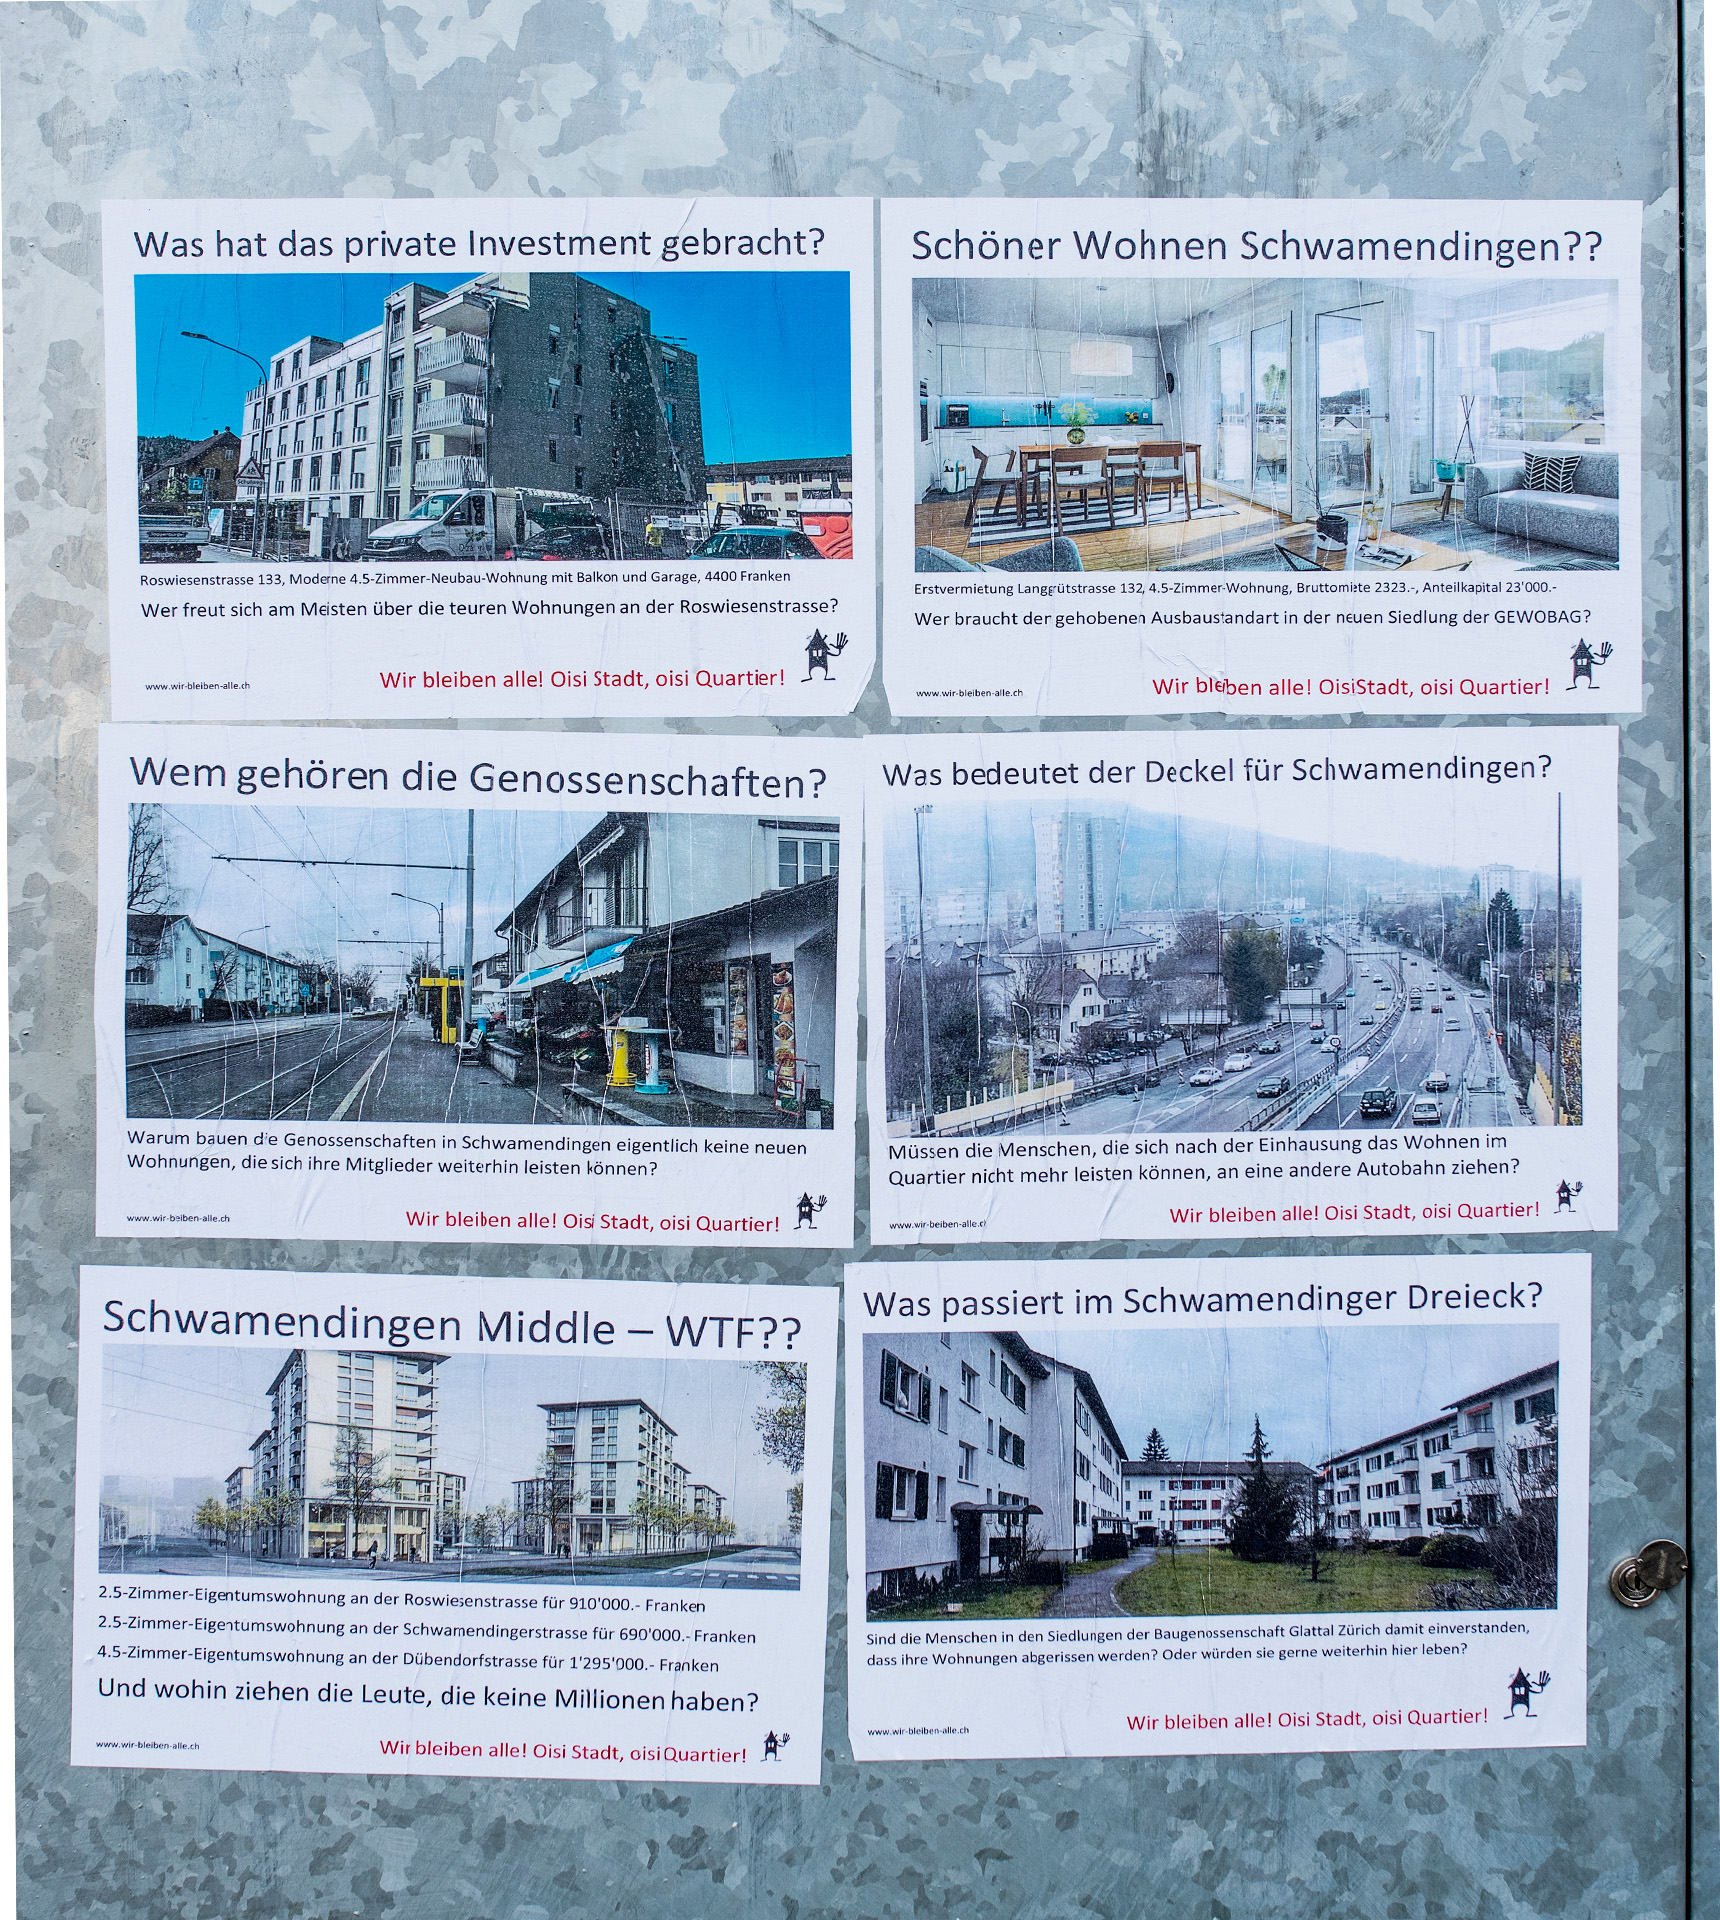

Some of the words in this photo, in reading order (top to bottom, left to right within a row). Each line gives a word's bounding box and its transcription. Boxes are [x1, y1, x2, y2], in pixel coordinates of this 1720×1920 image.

[133, 232, 204, 257] Was
[216, 230, 268, 257] hat
[278, 229, 334, 257] das
[345, 230, 457, 263] private
[469, 230, 652, 256] Investment
[661, 228, 825, 262] gebracht?
[912, 229, 1062, 260] Schöner
[1072, 229, 1227, 260] Wohnen
[1240, 230, 1603, 268] Schwamendingen??
[140, 575, 255, 586] Roswiesenstrasse
[258, 574, 286, 586] 133,
[289, 573, 347, 584] Moderne
[349, 572, 548, 585] 4.5-Zimmer-Neubau-Wohnung
[551, 572, 574, 583] mit
[576, 571, 619, 582] Balkon
[622, 571, 647, 582] und
[650, 572, 701, 584] Garage,
[704, 571, 738, 581] 4400
[740, 570, 791, 581] Franken
[914, 584, 1014, 596] Erstvermietung
[1120, 583, 1146, 595] 132,
[1148, 582, 1293, 595] 4.5-Zimmer-Wohnung,
[1374, 582, 1419, 594] 2323.-,
[1422, 582, 1502, 595] Anteilkapital
[1505, 581, 1557, 592] 23'000.-
[140, 603, 179, 617] Wer
[182, 602, 226, 617] freut
[230, 602, 263, 616] sich
[268, 606, 295, 616] am
[300, 602, 368, 616] Meisten
[373, 601, 414, 615] über
[418, 601, 445, 615] die
[448, 602, 507, 615] teuren
[511, 600, 616, 617] Wohnungen
[619, 603, 641, 614] an
[645, 599, 675, 613] der
[680, 598, 839, 613] Roswiesenstrasse?
[144, 682, 251, 690] www.wir-bleiben-alle.ch
[379, 672, 417, 688] Wir
[422, 671, 496, 688] bleiben
[502, 670, 543, 687] alle!
[550, 671, 587, 687] Oisi
[593, 670, 650, 689] Stadt,
[655, 670, 689, 686] oisi
[695, 669, 785, 688] Quartier!
[915, 689, 1024, 697] www.wir-bleiben-alle.ch
[129, 757, 227, 786] Wem
[236, 758, 388, 795] gehören
[402, 760, 457, 791] die
[469, 763, 827, 798] Genossenschaften?
[881, 764, 942, 786] Was
[952, 761, 1080, 785] bedeutet
[1088, 760, 1136, 783] der
[1145, 758, 1234, 782] Deckel
[1243, 758, 1284, 781] für
[1292, 755, 1552, 784] Schwamendingen?
[127, 1131, 190, 1144] Warum
[196, 1131, 248, 1146] bauen
[283, 1133, 436, 1148] Genossenschaften
[442, 1135, 457, 1149] in
[461, 1135, 611, 1154] Schwamendingen
[616, 1138, 698, 1155] eigentlich
[704, 1139, 750, 1153] keine
[754, 1144, 807, 1154] neuen
[888, 1145, 959, 1160] Müssen
[965, 1143, 993, 1158] die
[1102, 1140, 1130, 1155] die
[1134, 1139, 1169, 1154] sich
[1175, 1138, 1217, 1154] nach
[1223, 1138, 1254, 1153] der
[1259, 1137, 1363, 1154] Einhausung
[1367, 1135, 1398, 1150] das
[1403, 1134, 1480, 1149] Wohnen
[1486, 1134, 1507, 1148] im
[888, 1170, 967, 1187] Quartier
[971, 1168, 1015, 1183] nicht
[1020, 1167, 1069, 1182] mehr
[1074, 1166, 1133, 1182] leisten
[1139, 1165, 1211, 1182] können,
[1217, 1167, 1239, 1179] an
[1244, 1163, 1284, 1178] eine
[1288, 1162, 1352, 1177] andere
[1356, 1160, 1446, 1176] Autobahn
[1451, 1158, 1520, 1174] ziehen?
[862, 1292, 931, 1317] Was
[942, 1290, 1064, 1322] passiert
[1075, 1289, 1113, 1314] im
[1123, 1284, 1398, 1316] Schwamendinger
[1408, 1282, 1543, 1309] Dreieck?
[103, 1299, 461, 1347] Schwamendingen
[478, 1310, 615, 1345] Middle
[665, 1315, 802, 1350] WTF??
[98, 1586, 346, 1607] 2.5-Zimmer-Eigentumswohnung
[350, 1595, 369, 1604] an
[373, 1592, 400, 1605] der
[404, 1593, 538, 1608] Roswiesenstrasse
[542, 1596, 566, 1609] für
[569, 1597, 641, 1610] 910'000.-
[645, 1599, 706, 1612] Franken
[866, 1633, 896, 1645] Sind
[900, 1633, 922, 1644] die
[925, 1631, 998, 1644] Menschen
[1001, 1632, 1014, 1642] in
[1018, 1631, 1044, 1642] den
[1047, 1630, 1123, 1643] Siedlungen
[1126, 1628, 1151, 1640] der
[1154, 1625, 1286, 1642] Baugenossenschaft
[1288, 1625, 1334, 1637] Glattal
[1337, 1624, 1381, 1636] Zürich
[1384, 1623, 1425, 1635] damit
[1427, 1621, 1530, 1634] einverstanden,
[96, 1645, 345, 1666] 4.5-Zimmer-Eigentumswohnung
[348, 1654, 368, 1664] an
[371, 1651, 399, 1664] der
[403, 1652, 538, 1668] Dübendorfstrasse
[542, 1655, 565, 1668] für
[659, 1659, 719, 1672] Franken
[866, 1654, 898, 1666] dass
[901, 1654, 929, 1665] ihre
[931, 1653, 1018, 1666] Wohnungen
[1021, 1651, 1095, 1665] abgerissen
[1097, 1649, 1159, 1661] werden?
[1162, 1648, 1198, 1660] Oder
[1200, 1647, 1252, 1659] würden
[1255, 1647, 1275, 1658] sie
[1278, 1649, 1318, 1660] gerne
[1321, 1644, 1388, 1657] weiterhin
[1391, 1644, 1419, 1655] hier
[1422, 1643, 1468, 1655] leben?
[98, 1678, 146, 1697] Und
[154, 1679, 227, 1699] wohin
[235, 1681, 309, 1701] ziehen
[317, 1682, 354, 1702] die
[362, 1684, 432, 1707] Leute,
[441, 1685, 476, 1705] die
[484, 1686, 547, 1707] keine
[555, 1689, 665, 1709] Millionen
[671, 1690, 759, 1712] haben?
[867, 1726, 970, 1735] www.wir-bleiben-alle.ch
[1126, 1716, 1160, 1730] Wir
[1164, 1714, 1229, 1729] bleiben
[1234, 1713, 1272, 1728] alle!
[1278, 1712, 1310, 1727] Oisi
[1315, 1710, 1367, 1728] Stadt,
[1372, 1710, 1402, 1725] oisi
[1407, 1708, 1488, 1726] Quartier!
[95, 1741, 200, 1749] www.wir-bleiben-alle.ch
